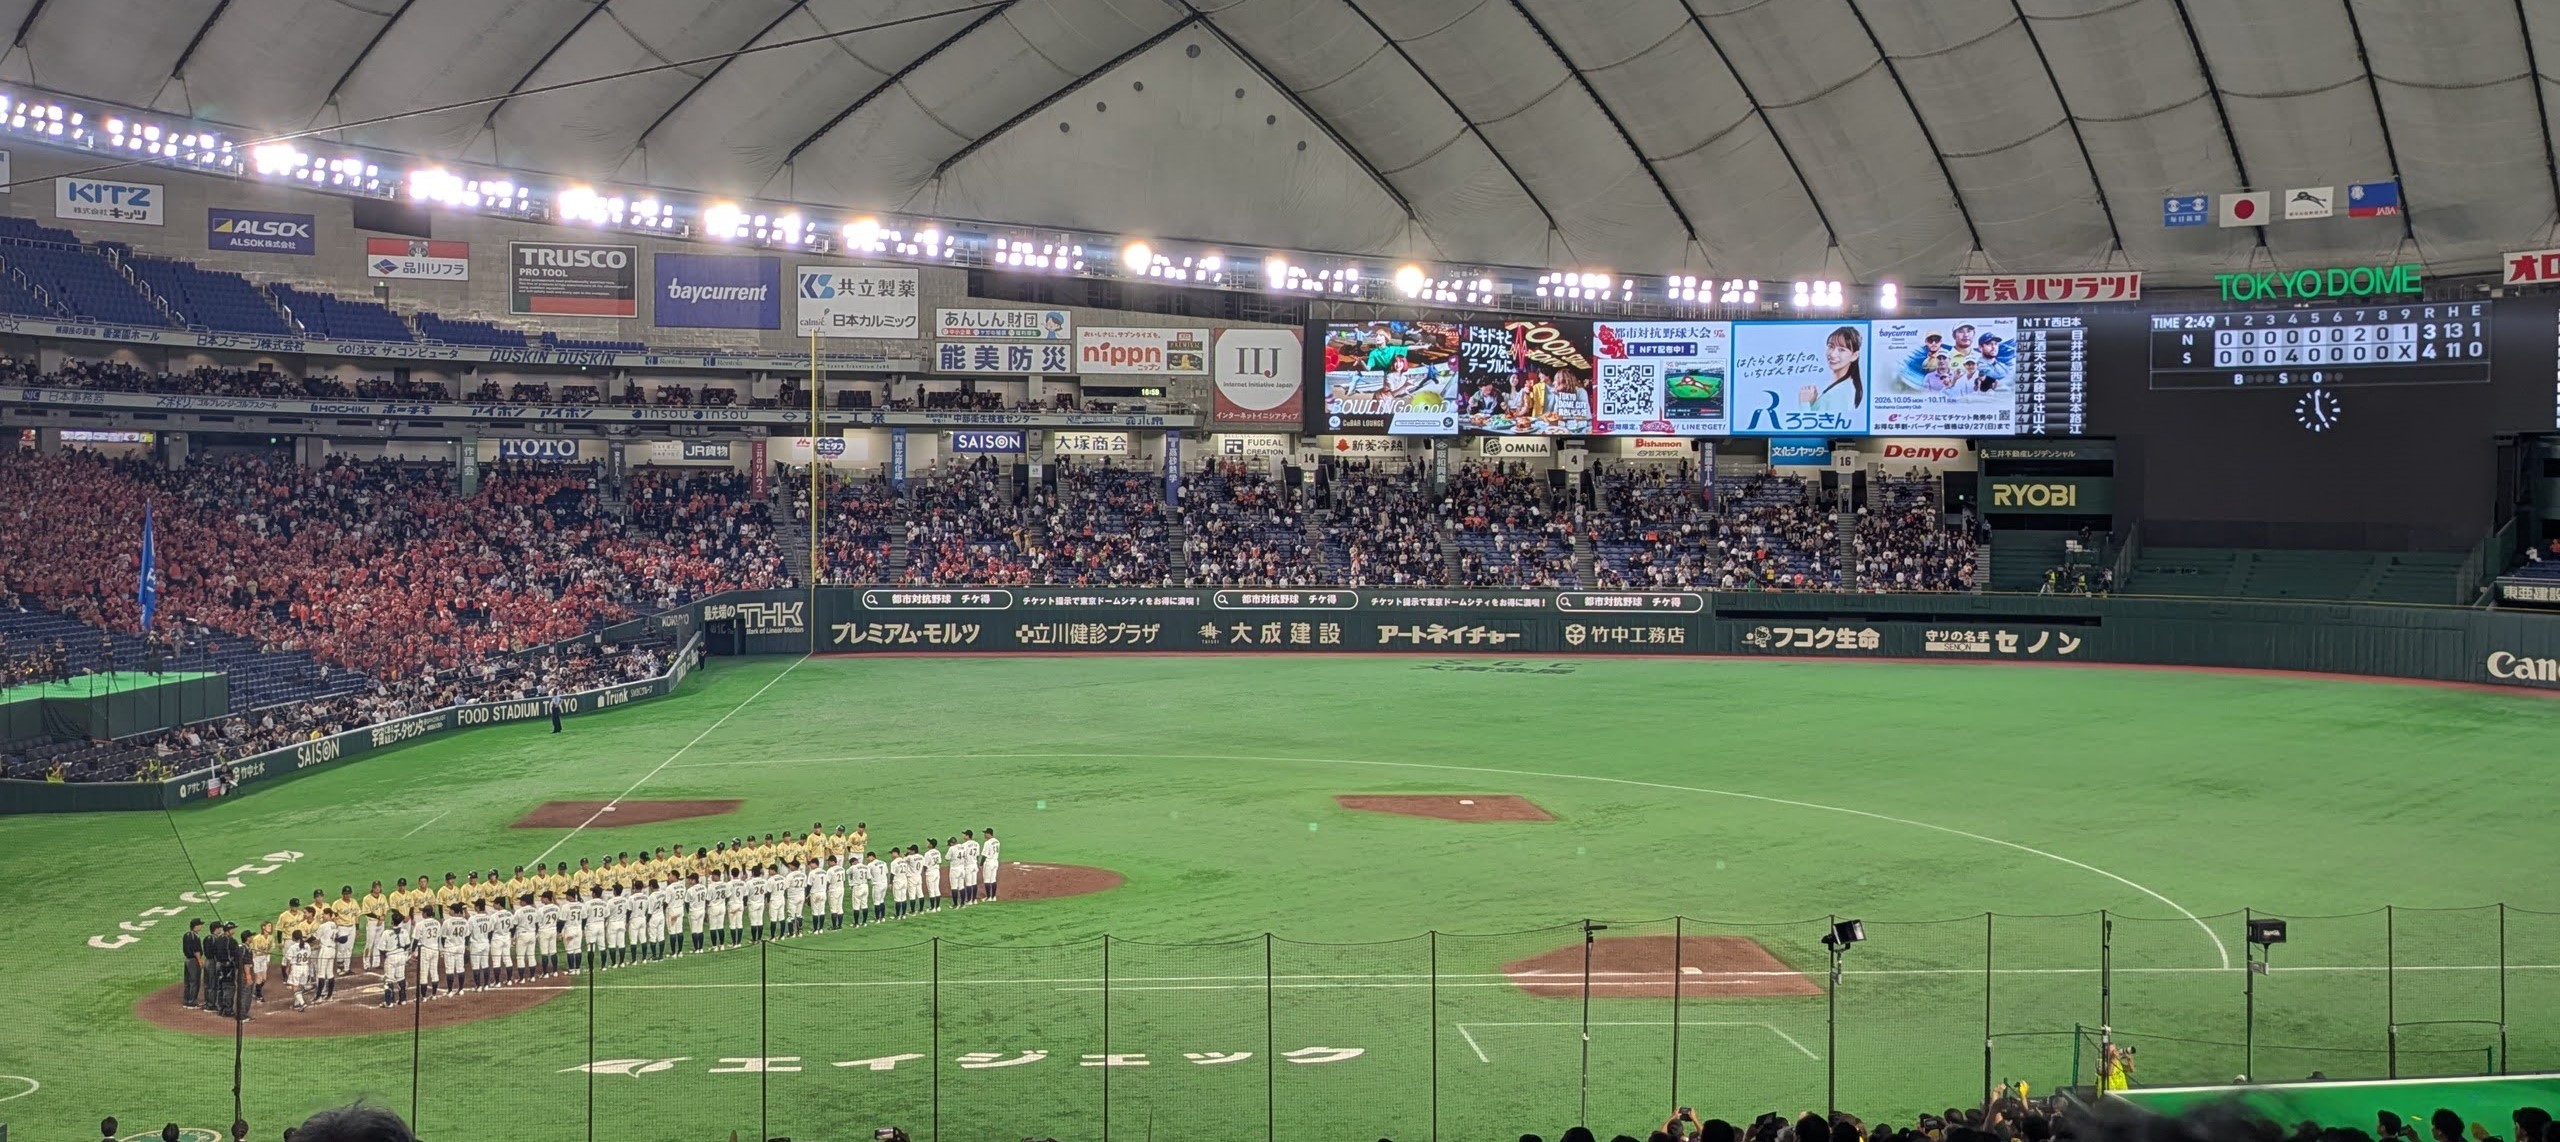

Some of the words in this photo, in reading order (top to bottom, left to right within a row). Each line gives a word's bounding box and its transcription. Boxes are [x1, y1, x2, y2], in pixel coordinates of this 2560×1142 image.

[69, 181, 150, 207] KITZ
[233, 219, 310, 239] ALSOK
[519, 248, 628, 269] TRUSCO
[403, 260, 465, 276] 品川リフラ
[519, 268, 540, 277] PRO
[542, 268, 568, 278] TOOL
[838, 278, 916, 298] 共立製薬
[1963, 274, 2139, 301] 元気ハツラツ!
[2215, 268, 2324, 301] TOKYO
[2326, 264, 2423, 297] DOME
[668, 278, 768, 304] baycurrent
[833, 314, 917, 328] 日本カルミック
[944, 311, 1038, 328] あんしん財団
[2152, 317, 2180, 329] TIME
[2185, 315, 2215, 329] 2:49
[2224, 316, 2230, 326] 1
[2244, 315, 2253, 326] 2
[2266, 314, 2275, 325] 3
[2287, 313, 2298, 324] 4
[2310, 312, 2320, 323] 5
[2332, 311, 2343, 322] 6
[2355, 310, 2365, 321] 7
[2378, 309, 2388, 320] 8
[2400, 308, 2411, 319] 9
[2425, 307, 2435, 318] R
[2448, 305, 2459, 317] H
[2471, 305, 2481, 316] E
[1469, 326, 1513, 344] ドキドキと
[1614, 327, 1712, 339] 都市対抗野球大会
[1878, 328, 1919, 338] baycurrent
[2182, 334, 2194, 346] N
[2220, 332, 2232, 346] 0
[2242, 331, 2254, 345] 0
[2264, 331, 2277, 345] 0
[2286, 330, 2299, 344] 0
[2308, 329, 2321, 343] 0
[2331, 328, 2344, 342] 0
[2353, 327, 2366, 342] 2
[2376, 326, 2389, 341] 0
[2402, 326, 2409, 340] 1
[2422, 324, 2437, 339] 3
[2443, 322, 2464, 338] 13
[2472, 321, 2481, 337] 1
[197, 335, 304, 351] 日本ステージ株式会社
[489, 350, 550, 364] DUSKIN
[556, 352, 617, 366] DUSKIN
[940, 344, 1067, 372] 能美防災
[1083, 341, 1161, 367] nippn
[1736, 352, 1820, 369] はたらくあなたの、
[2182, 352, 2192, 364] S
[2219, 350, 2232, 364] 0
[2241, 350, 2254, 363] 0
[2264, 349, 2276, 363] 0
[2285, 348, 2299, 362] 4
[2308, 348, 2321, 362] 0
[2331, 347, 2343, 361] 0
[2353, 346, 2366, 361] 0
[2376, 345, 2388, 360] 0
[2398, 344, 2412, 359] X
[2421, 343, 2437, 359] 4
[2445, 342, 2461, 358] 11
[2469, 341, 2483, 357] 0
[1235, 347, 1282, 379] IIJ
[1275, 382, 1294, 390] Japan
[2234, 374, 2244, 385] B
[2279, 372, 2289, 384] S
[1559, 393, 1577, 401] TOKYO
[318, 405, 370, 414] HOCHIKI
[382, 404, 434, 415] ホーチキ
[472, 405, 527, 418] アイホン
[539, 407, 595, 419] アイホン
[1216, 411, 1299, 420] インターネットイニシアティブ
[1785, 412, 1852, 430] ろうきん
[502, 438, 577, 456] TOTO
[958, 434, 1021, 449] SAISON
[1055, 435, 1128, 451] 大塚商会
[1247, 438, 1284, 447] FUDEAL
[1351, 439, 1404, 452] 新菱冷熱
[1504, 443, 1548, 453] OMNIA
[1635, 438, 1682, 448] Bishamon
[685, 445, 729, 457] JR貨物
[1246, 448, 1284, 456] CREATION
[1303, 453, 1315, 463] 14
[1883, 444, 1959, 462] Denyo
[1570, 455, 1578, 465] 4
[1839, 455, 1852, 467] 16
[1992, 483, 2077, 507] RYOBI
[891, 594, 952, 605] 都市対抗野球
[961, 594, 991, 606] チケ得
[1241, 594, 1299, 605] 都市対抗野球
[1308, 594, 1338, 606] チケ得
[2503, 585, 2560, 601] 東亜建設
[1584, 596, 1643, 607] 都市対抗野球
[1652, 596, 1681, 608] チケ得
[704, 604, 736, 621] 最先端の
[736, 601, 804, 628] THK
[831, 622, 981, 645] プレミアム・モルツ
[1032, 622, 1161, 645] 立川健診プラザ
[1230, 621, 1341, 645] 大成建設
[1377, 623, 1521, 645] アートネイチャー
[1591, 626, 1686, 644] 竹中工務店
[1773, 626, 1881, 650] フコク生命
[1925, 630, 1990, 642] 守りの名手
[1995, 630, 2081, 655] セノン
[2487, 650, 2560, 682] Can
[605, 690, 629, 707] Trunk
[458, 708, 490, 726] FOOD
[492, 704, 540, 721] STADIUM
[297, 737, 340, 769] SAISON
[715, 890, 726, 900] 28
[754, 886, 765, 896] 26
[546, 913, 557, 924] 29
[570, 911, 582, 922] 51
[593, 907, 604, 918] 13
[426, 927, 438, 938] 33
[452, 926, 465, 937] 48
[478, 922, 488, 933] 10
[707, 1047, 1366, 1073] エイジェック
